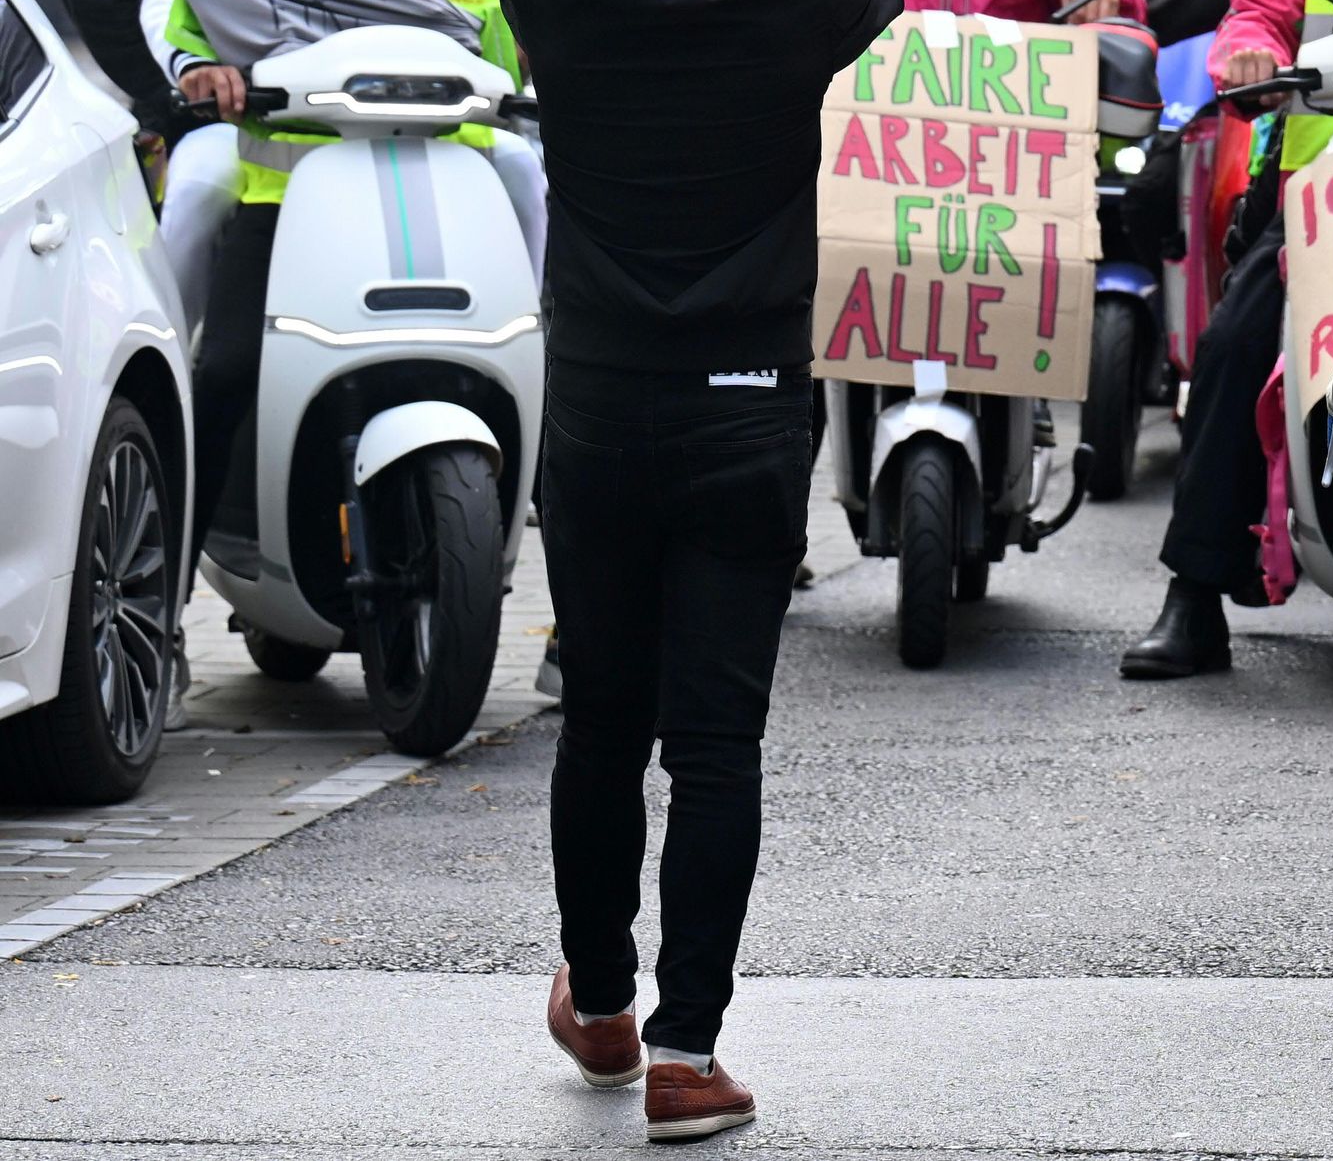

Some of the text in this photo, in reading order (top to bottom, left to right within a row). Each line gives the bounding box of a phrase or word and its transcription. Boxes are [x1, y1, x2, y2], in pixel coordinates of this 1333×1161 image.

[854, 26, 1073, 120] FAIRE
[833, 112, 1067, 199] ARBEIT
[895, 192, 1024, 276] FÜR
